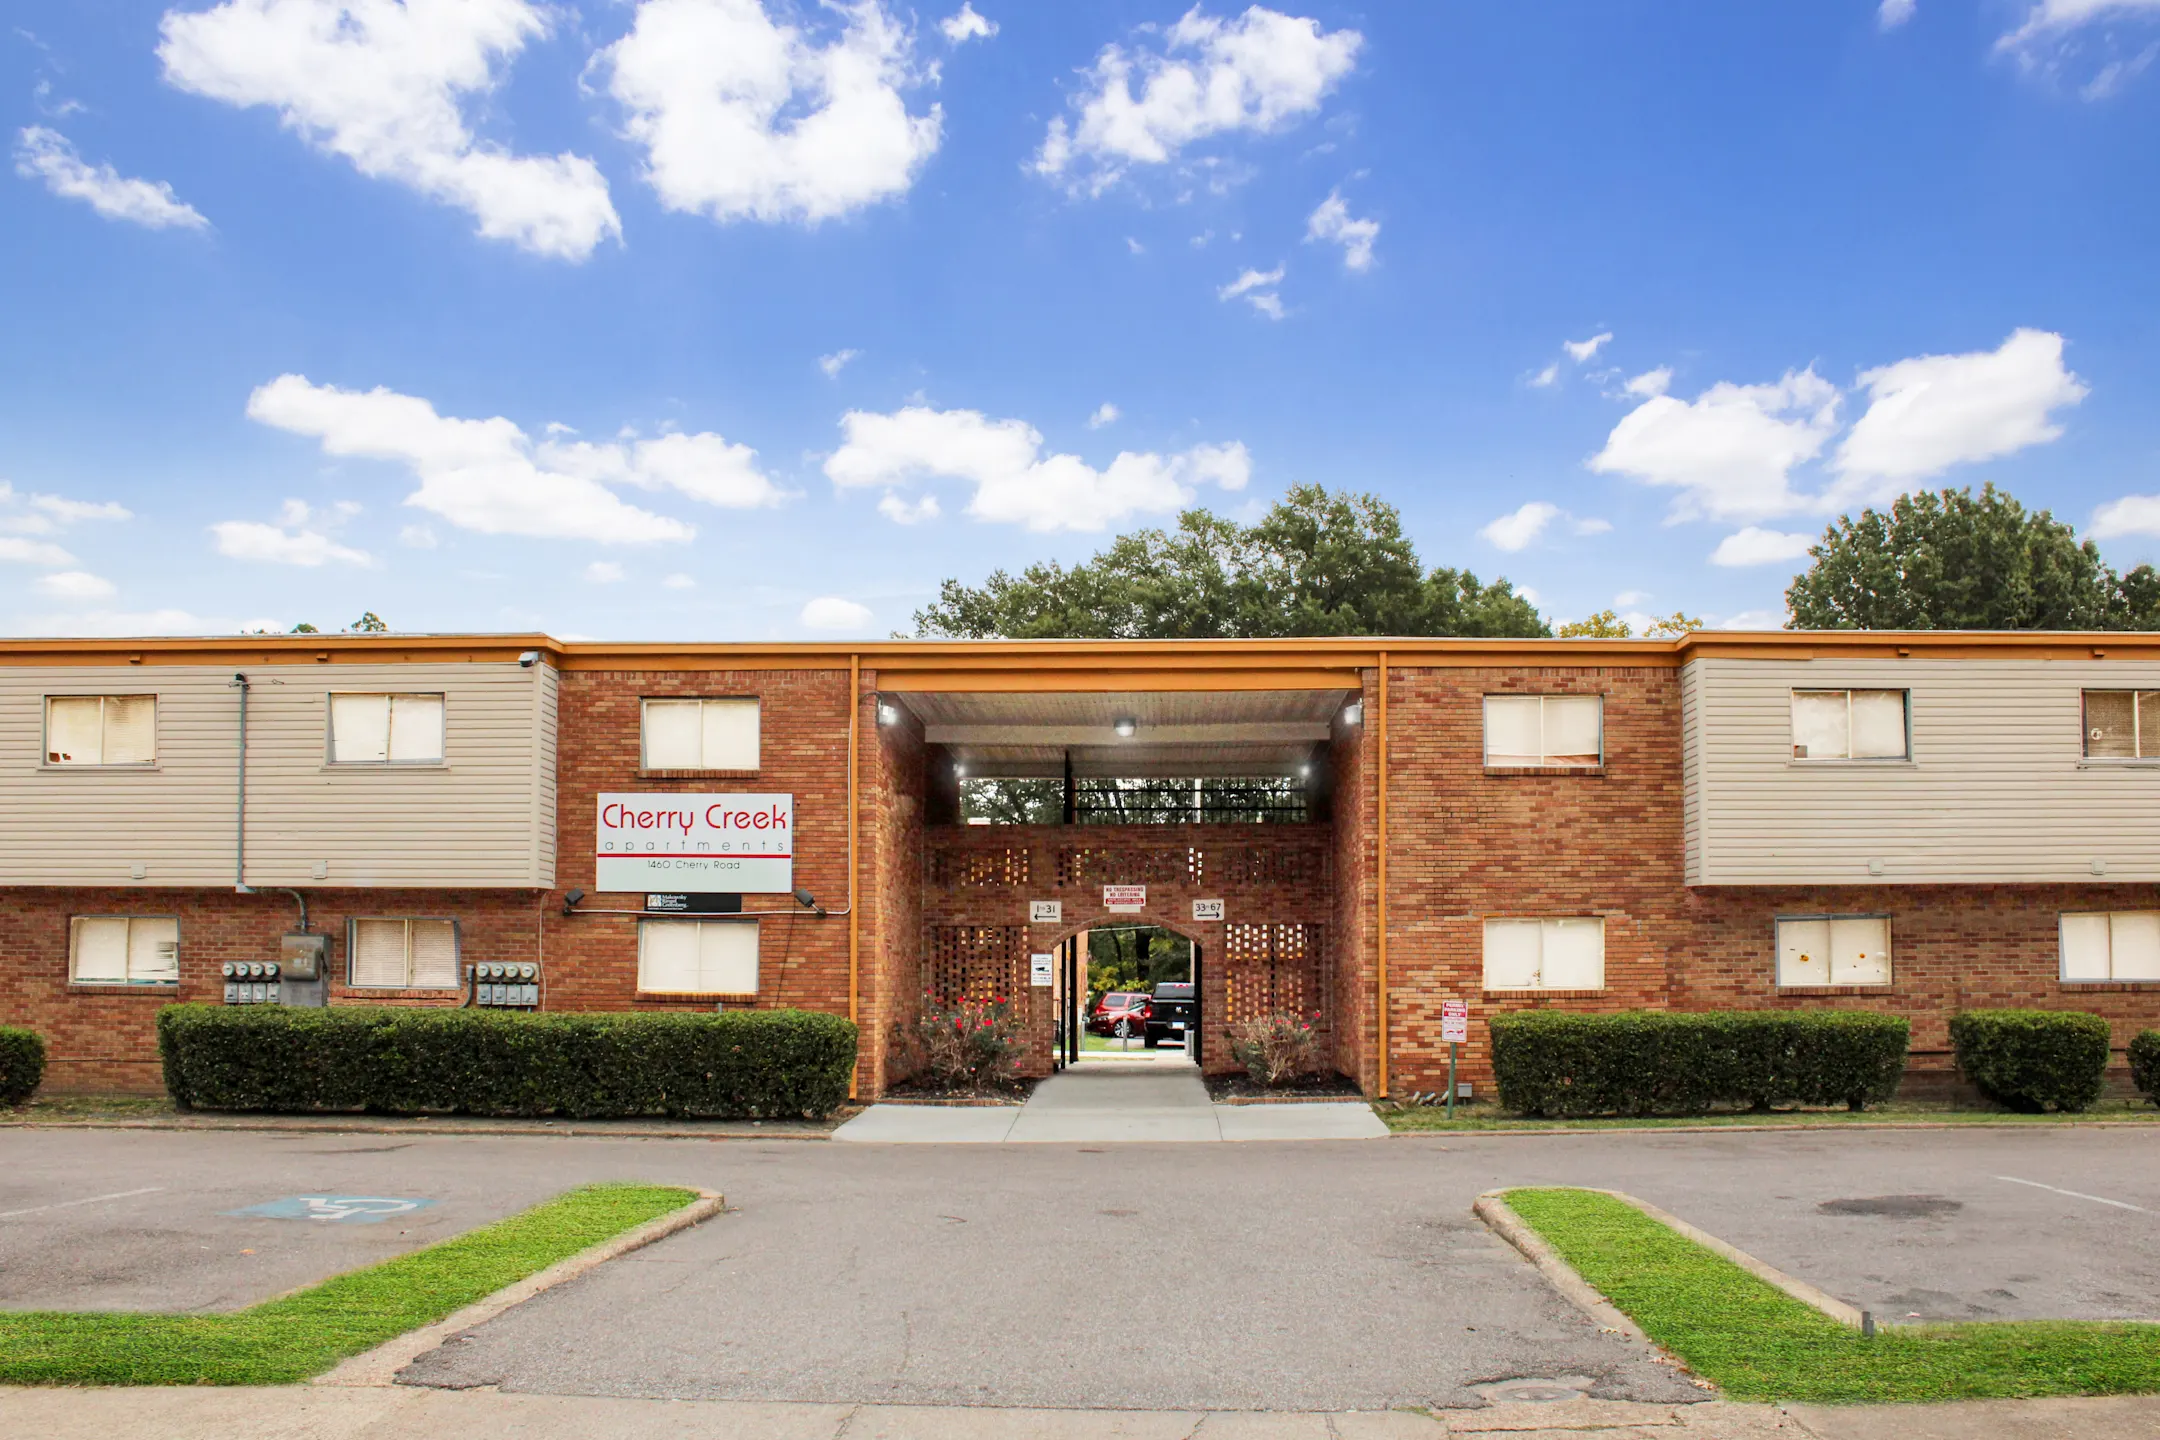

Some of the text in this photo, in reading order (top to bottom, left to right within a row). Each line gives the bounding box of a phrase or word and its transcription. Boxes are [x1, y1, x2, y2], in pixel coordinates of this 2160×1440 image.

[603, 803, 787, 836] Cherry Creek
[604, 839, 784, 852] apartments
[648, 860, 740, 870] 1460 Cherry Road
